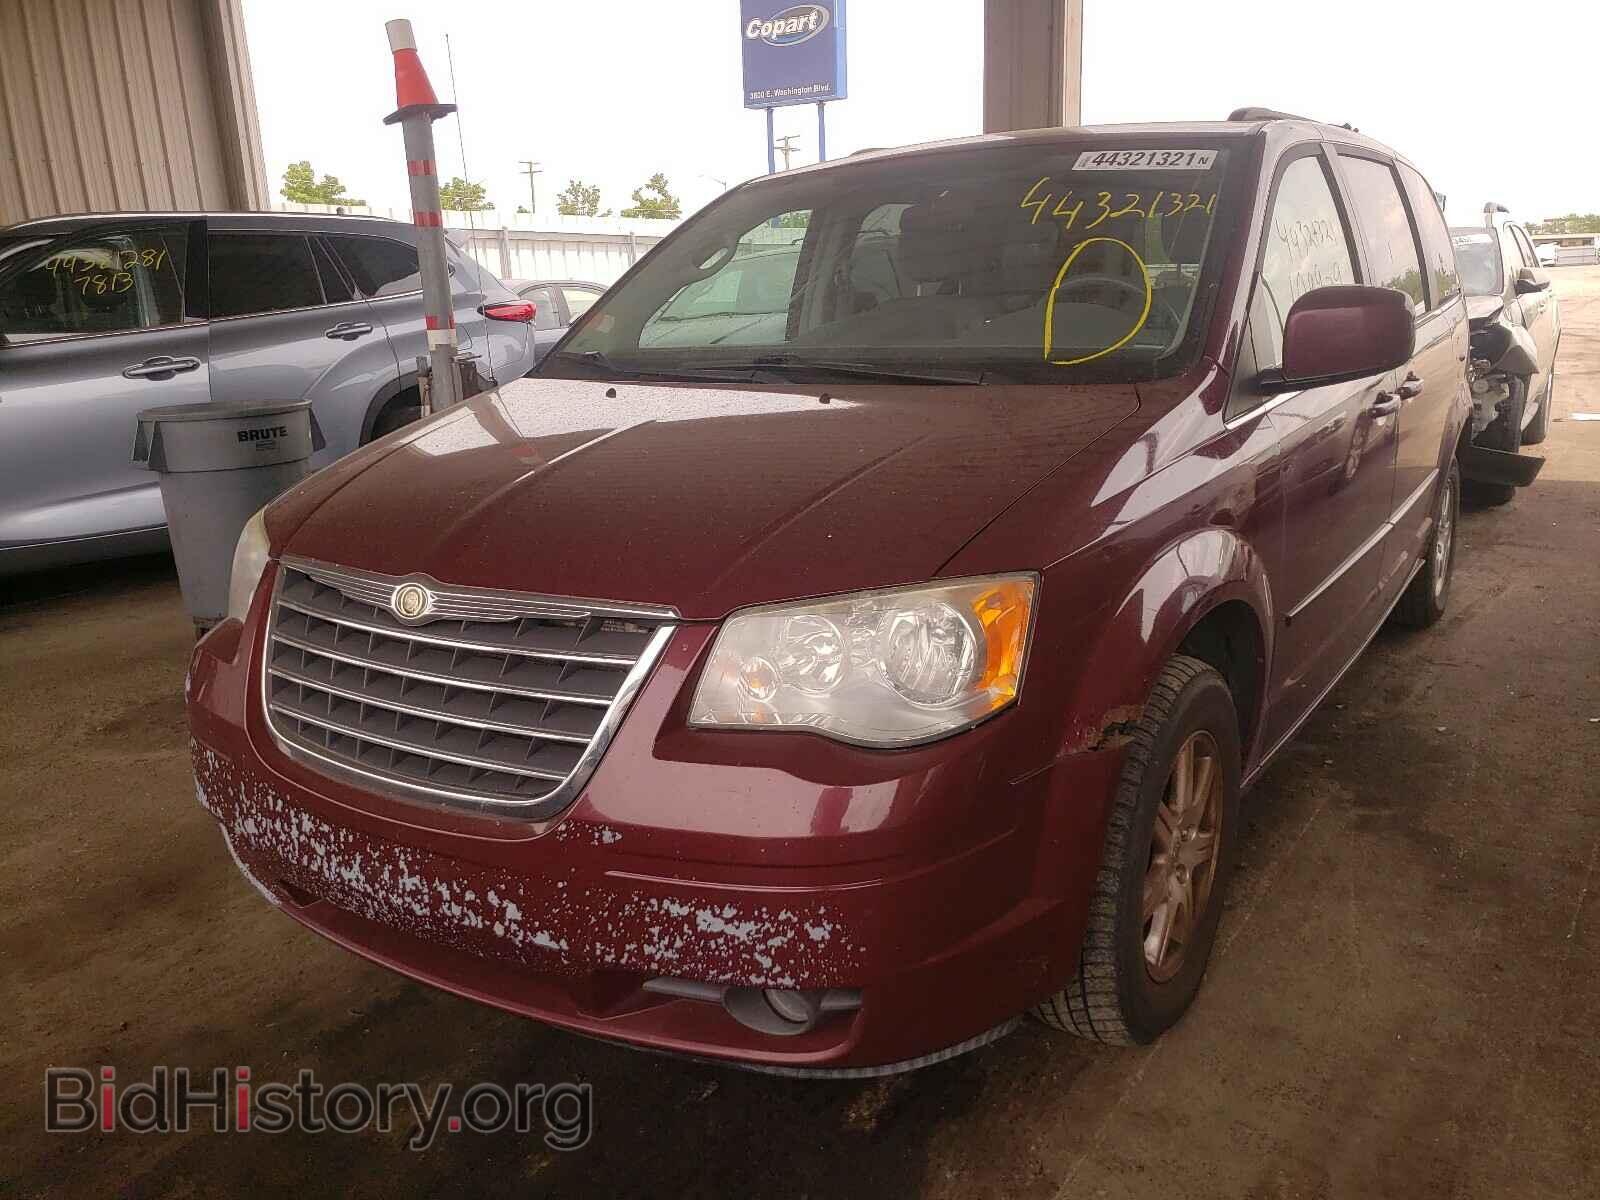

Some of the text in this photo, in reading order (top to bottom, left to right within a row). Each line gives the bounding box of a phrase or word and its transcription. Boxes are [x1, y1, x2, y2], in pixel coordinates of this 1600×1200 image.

[746, 8, 818, 40] Copart
[774, 86, 812, 97] Washington
[1092, 151, 1196, 167] 44321321
[1020, 177, 1217, 230] 44321321
[74, 272, 134, 295] 7813
[237, 425, 288, 442] BRUTE
